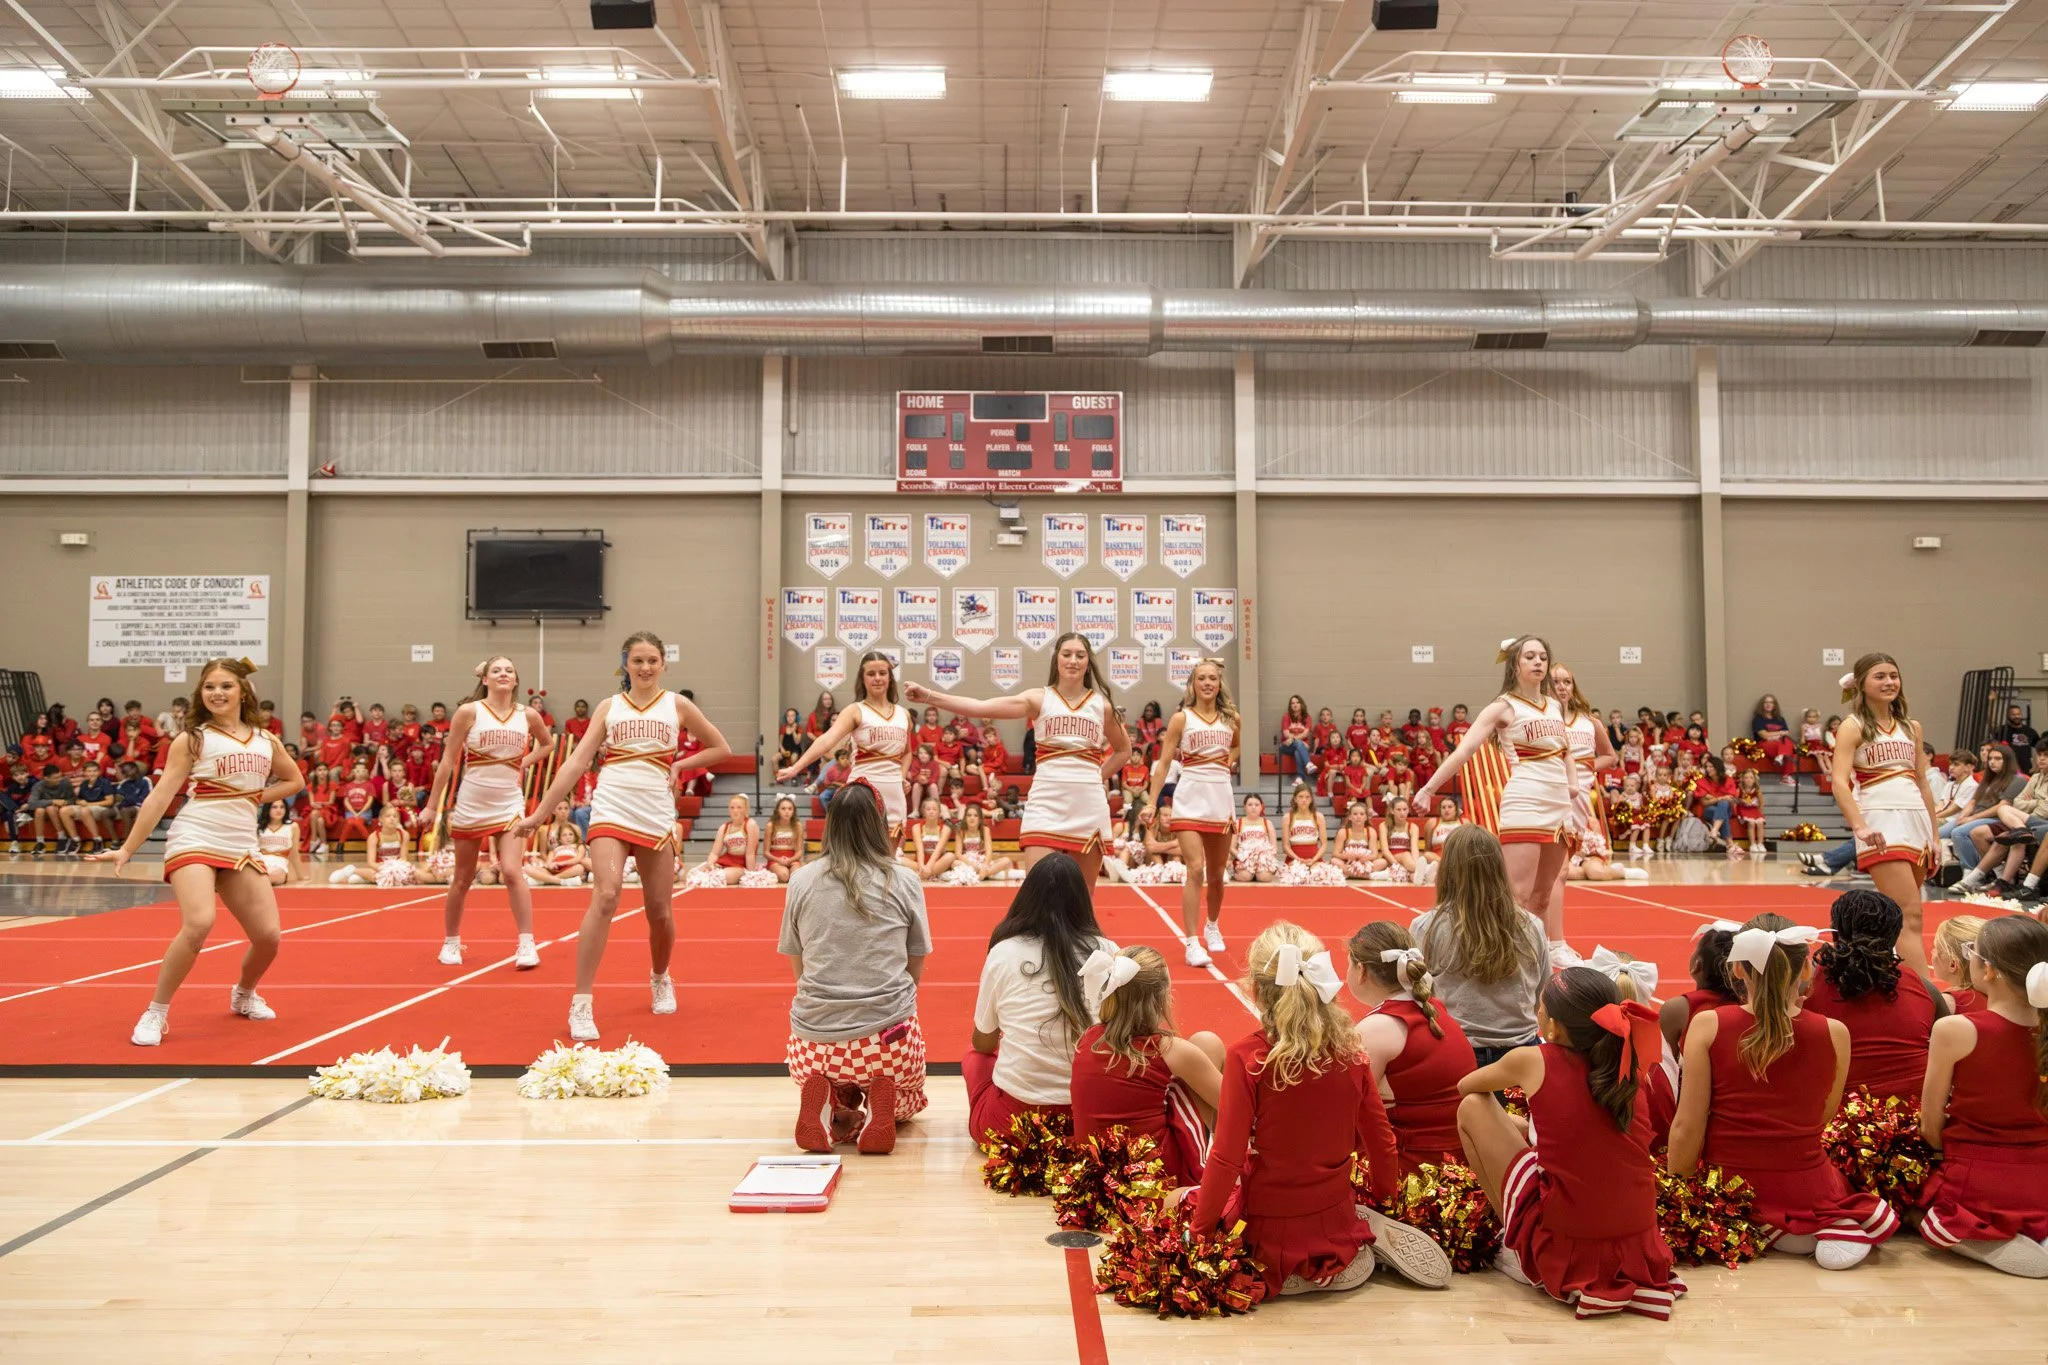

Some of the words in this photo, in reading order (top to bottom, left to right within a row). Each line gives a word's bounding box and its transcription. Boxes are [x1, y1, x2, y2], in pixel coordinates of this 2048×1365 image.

[906, 396, 944, 408] HOME
[1072, 396, 1114, 409] GUEST
[990, 429, 1014, 437] PERIOD
[1016, 444, 1033, 452] FOUL
[1091, 444, 1113, 452] FOULS
[905, 469, 928, 477] SCORE
[949, 482, 984, 490] Donated
[986, 482, 997, 492] by
[999, 482, 1028, 490] Electra
[1102, 482, 1118, 490] Inc.
[1105, 542, 1142, 550] BASKETBALL
[810, 548, 848, 556] CHAMPIONS
[870, 548, 908, 557] CHAMPION
[928, 548, 966, 557] CHAMPION
[1046, 548, 1084, 556] CHAMPION
[820, 559, 839, 568] 2018
[937, 558, 957, 566] 2020
[1055, 558, 1074, 566] 2021
[116, 578, 162, 588] ATHLETICS
[165, 578, 187, 588] CODE
[190, 578, 200, 588] OF
[204, 578, 244, 588] CONDUCT
[786, 614, 822, 622] VOLLEYBALL
[840, 614, 876, 623] BASKETBALL
[898, 614, 936, 622] BASKETBALL
[1018, 614, 1056, 622] TENNIS
[1135, 616, 1172, 624] VOLLEYBALL
[1204, 616, 1226, 624] GOLF
[766, 598, 776, 660] WARRIORS
[784, 622, 822, 630] CHAMPION
[898, 622, 936, 630] CHAMPIONS
[1018, 622, 1056, 630] CHAMPION
[1076, 622, 1114, 631] CHAMPION
[1196, 624, 1233, 632] CHAMPION
[1242, 598, 1252, 660] WARRIORS
[794, 632, 814, 640] 2022
[848, 632, 868, 640] 2022
[956, 628, 994, 636] CHAMPION
[1086, 632, 1105, 640] 2023
[612, 720, 671, 744] WARRIORS
[1045, 716, 1100, 742] WARRIORS
[480, 729, 526, 750] WARRIORS
